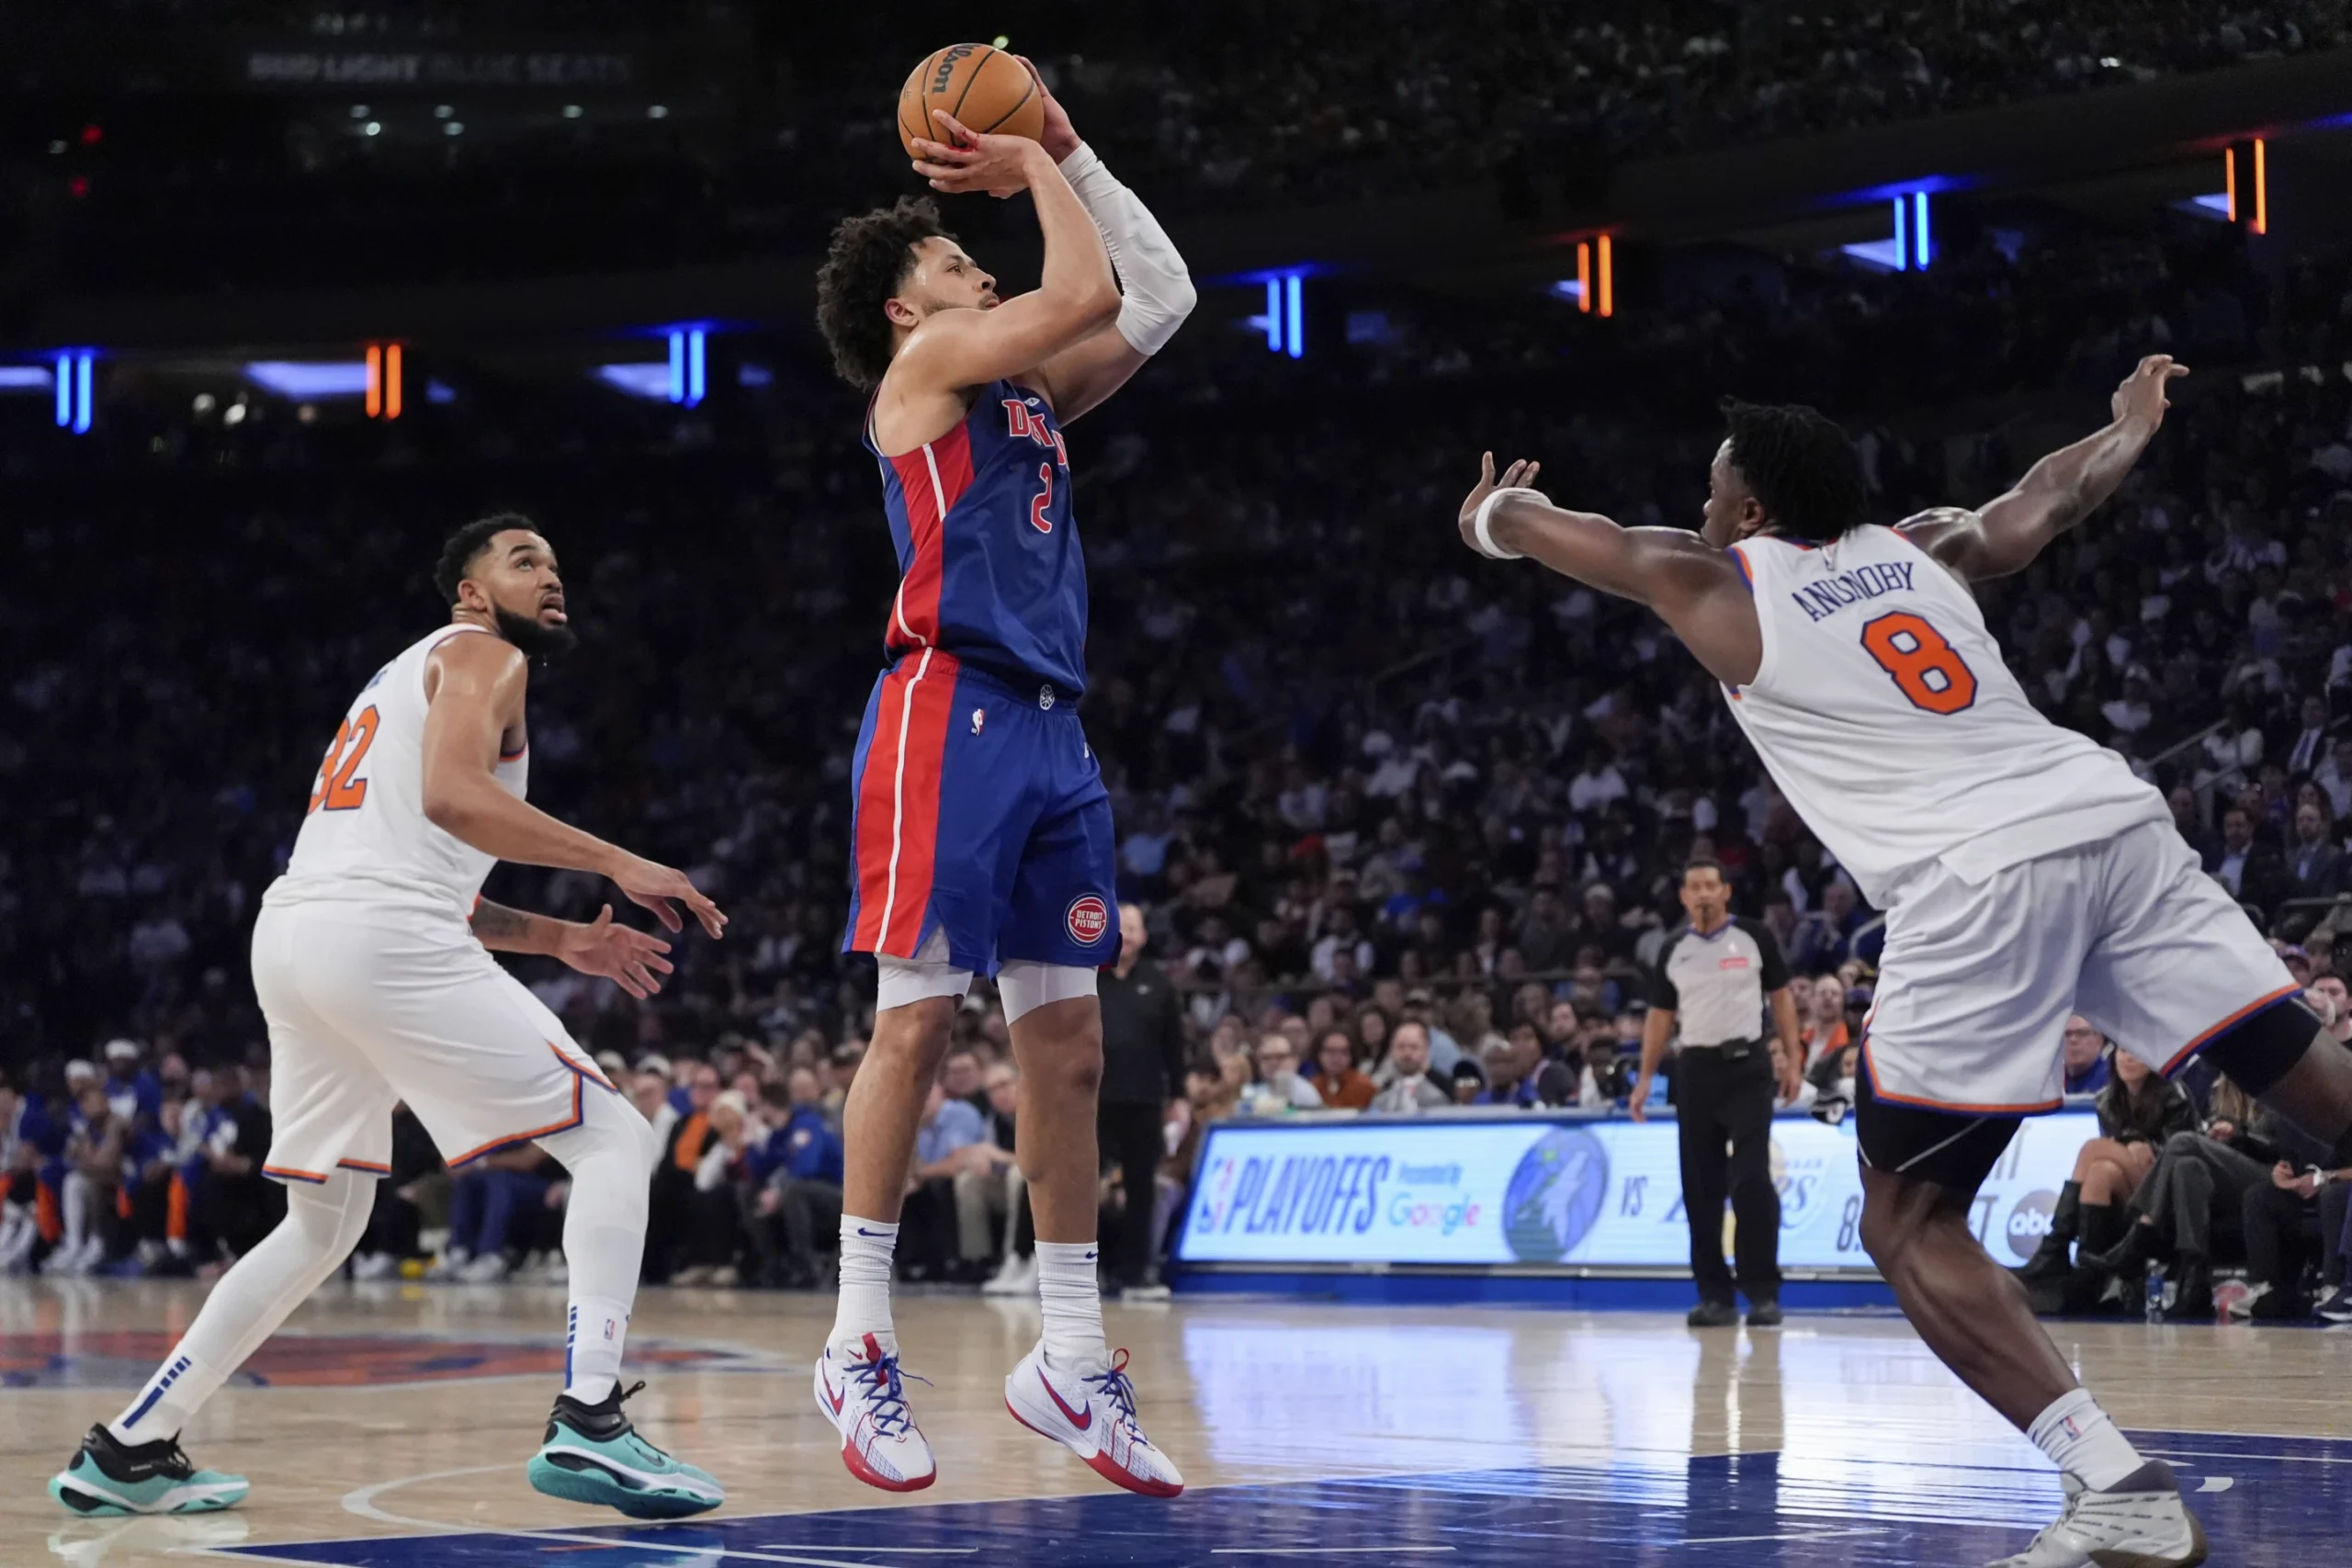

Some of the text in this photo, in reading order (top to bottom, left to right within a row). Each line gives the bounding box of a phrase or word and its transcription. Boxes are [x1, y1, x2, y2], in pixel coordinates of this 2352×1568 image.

[1030, 461, 1053, 535] 2
[1792, 561, 1915, 622] ANUNOBY
[1860, 611, 1979, 716] 8
[1075, 918, 1102, 930] PISTONS
[1076, 909, 1103, 920] DETROIT
[1223, 1155, 1392, 1235] PLAYOFFS
[1387, 1191, 1481, 1236] Google
